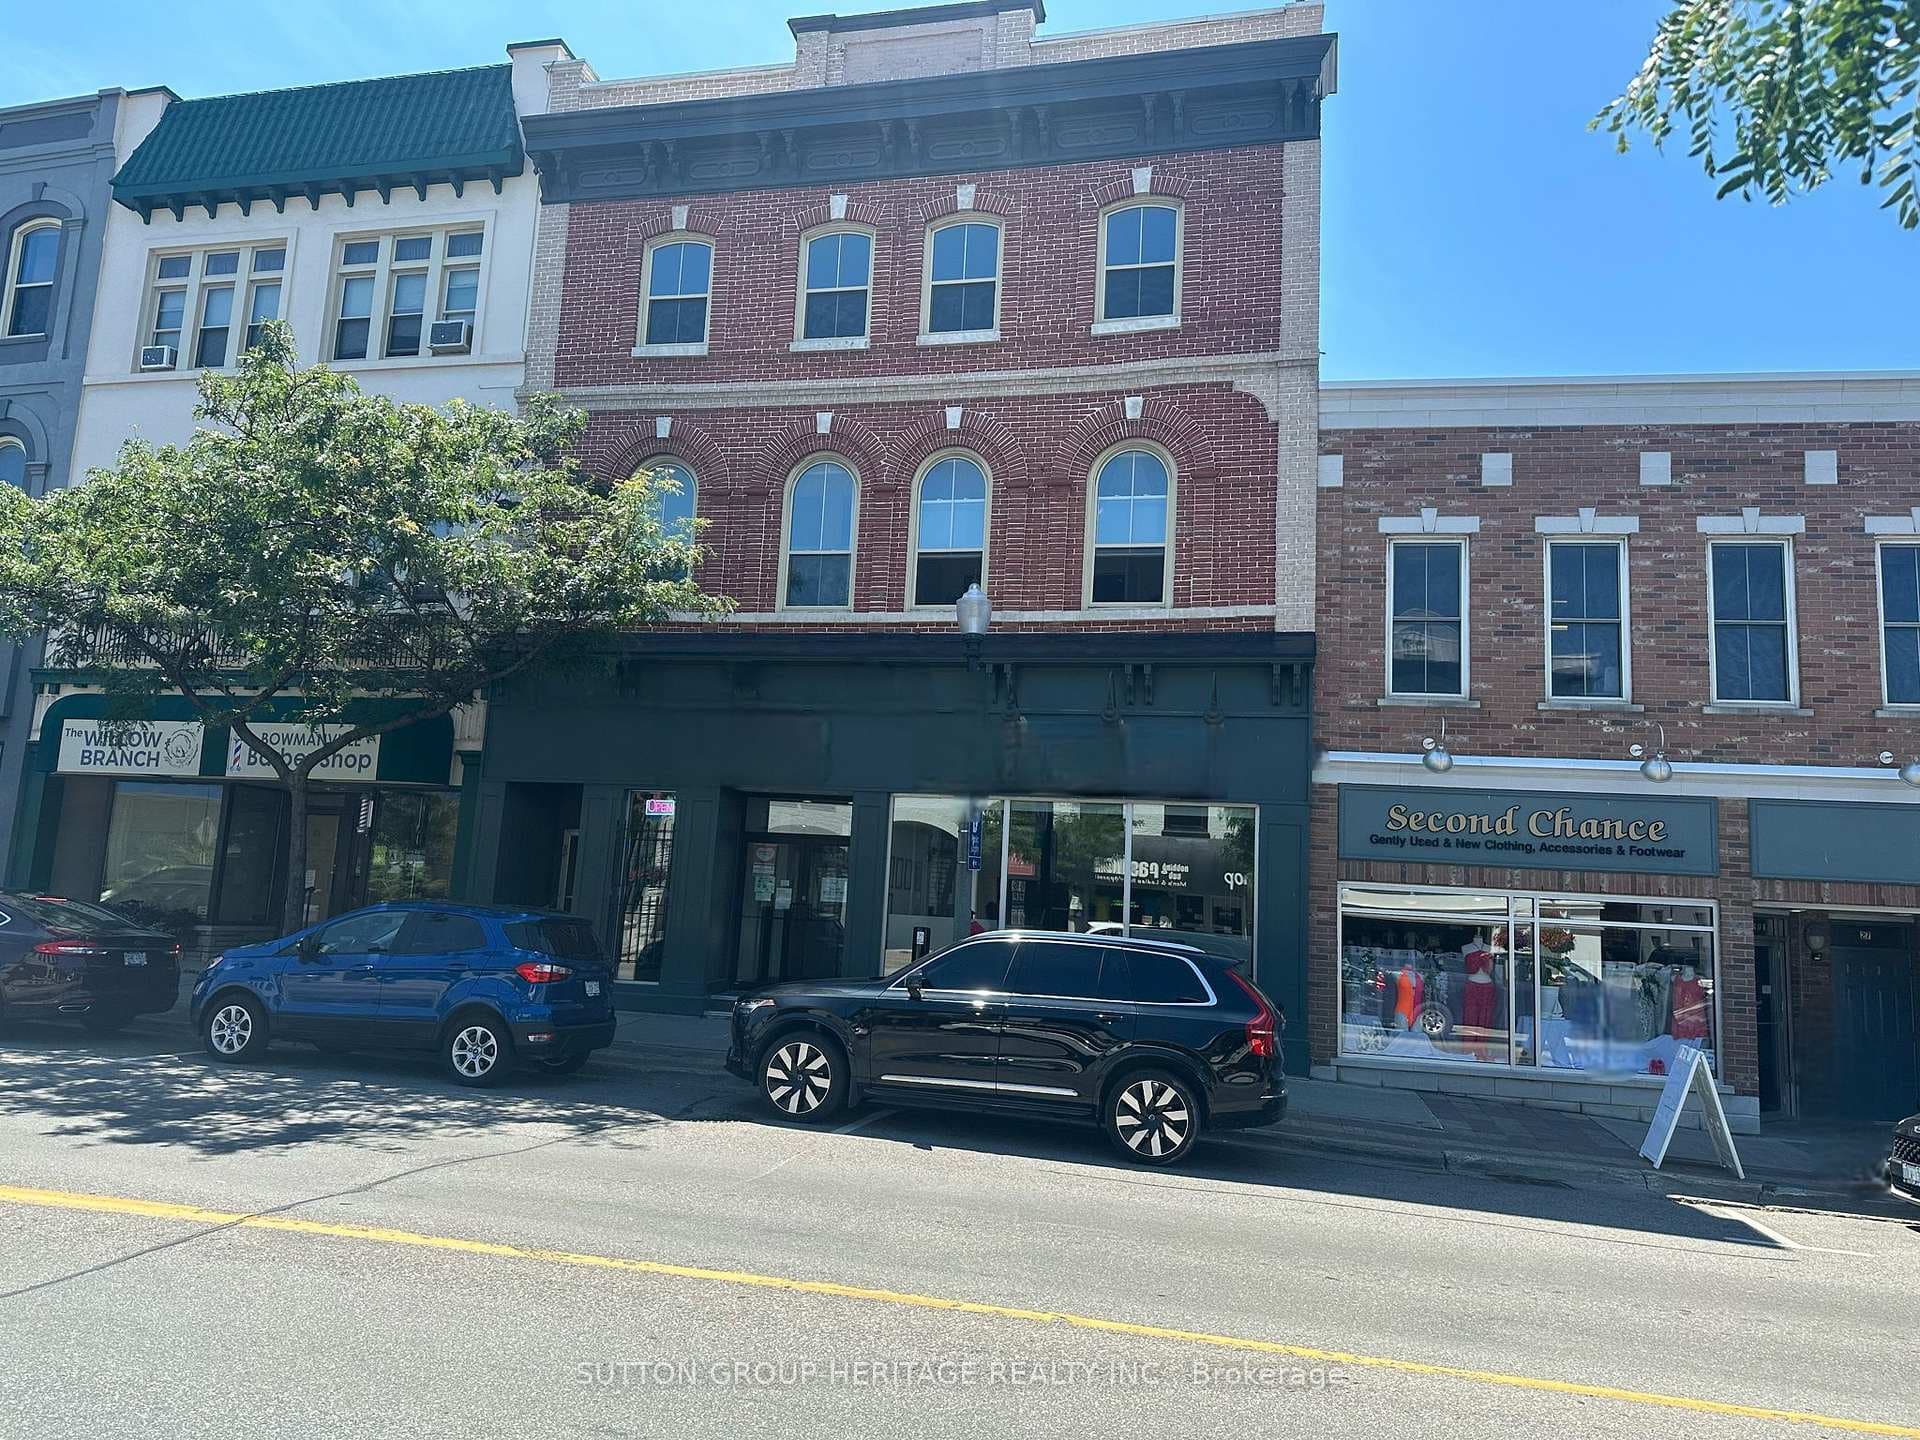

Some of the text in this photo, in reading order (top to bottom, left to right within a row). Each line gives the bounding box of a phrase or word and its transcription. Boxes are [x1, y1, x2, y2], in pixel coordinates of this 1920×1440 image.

[65, 728, 83, 738] The
[80, 750, 161, 767] BRANCH
[247, 748, 305, 767] Babe
[1385, 803, 1668, 842] Second Chance
[1369, 833, 1685, 858] Gently Used & New Clothing, Accessories & Footwear
